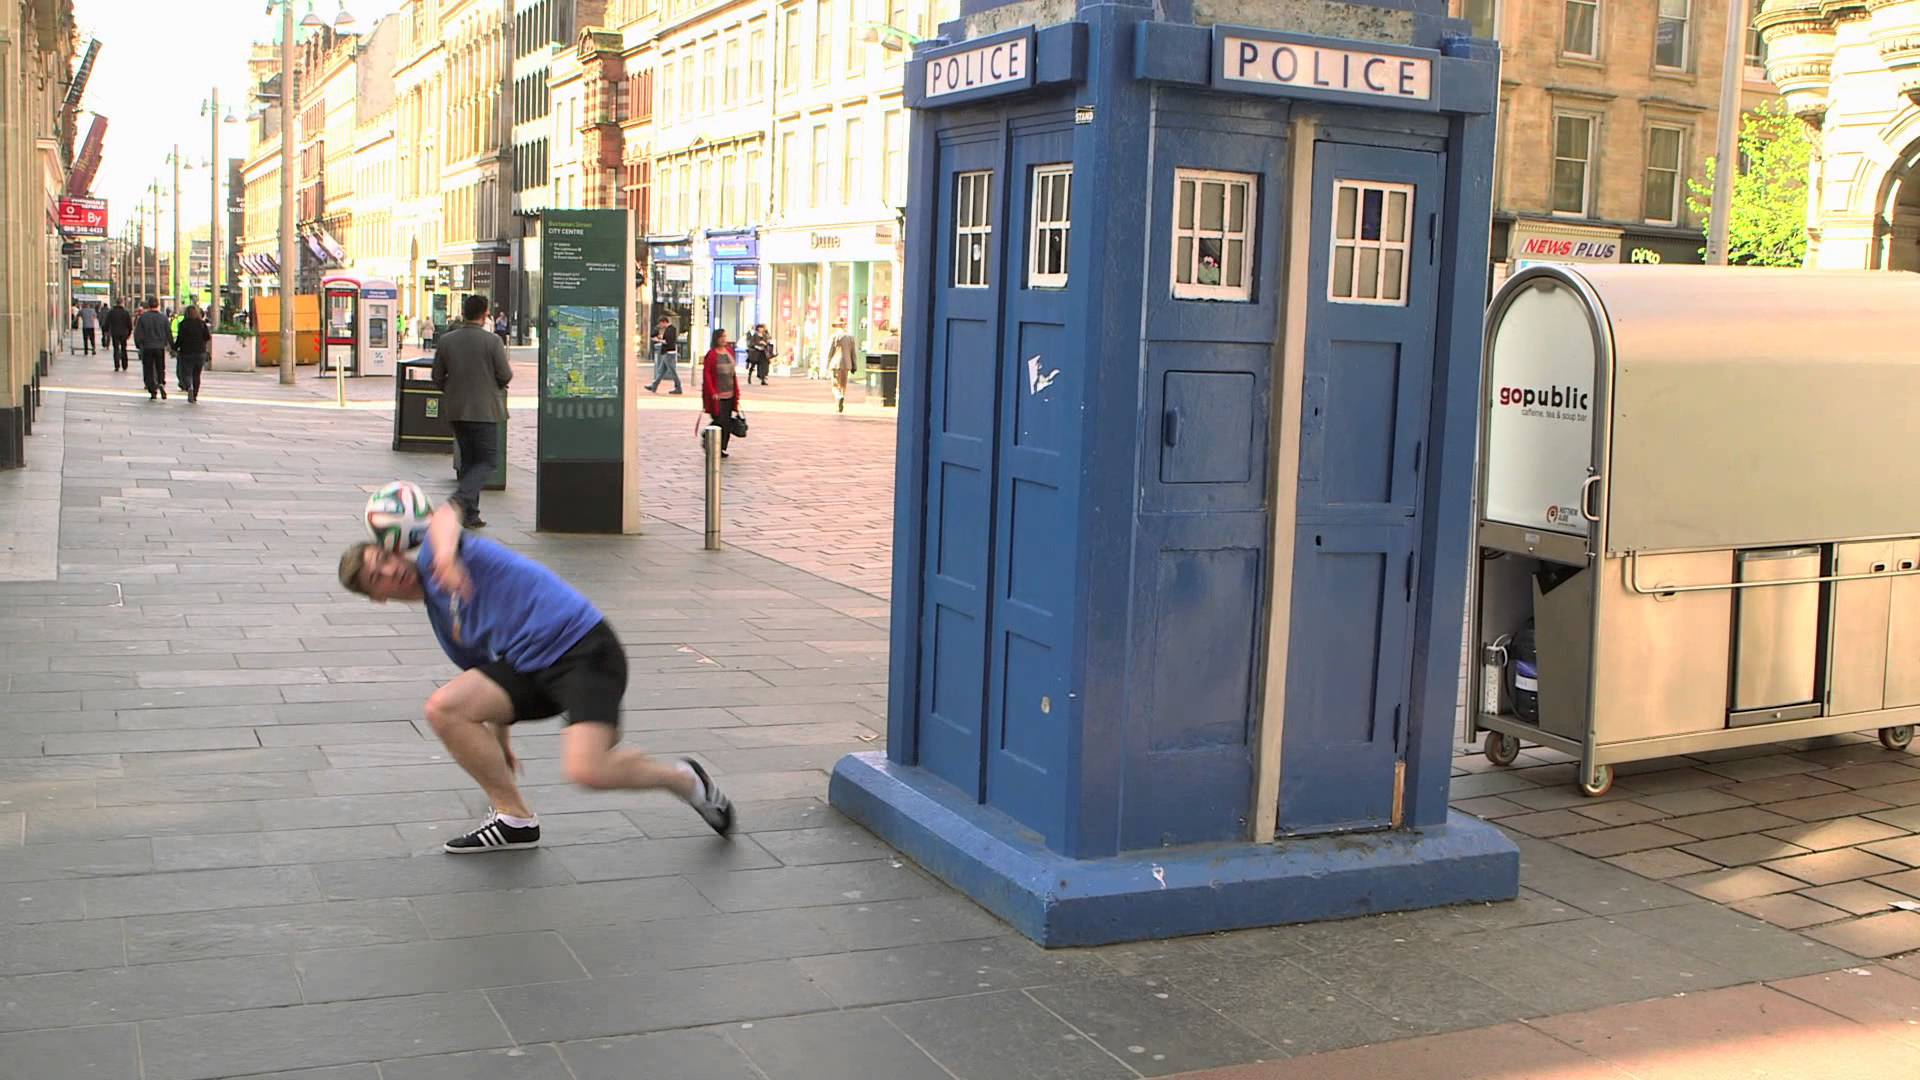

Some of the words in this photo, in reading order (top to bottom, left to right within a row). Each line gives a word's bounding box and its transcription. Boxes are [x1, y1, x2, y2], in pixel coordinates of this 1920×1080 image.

[932, 41, 1020, 92] POLICE
[1239, 41, 1415, 96] POLICE
[561, 228, 584, 236] CENTRE
[810, 232, 841, 249] Dune
[1522, 239, 1572, 255] NEWS
[1573, 242, 1616, 258] PLUS
[1500, 385, 1588, 410] gopublic
